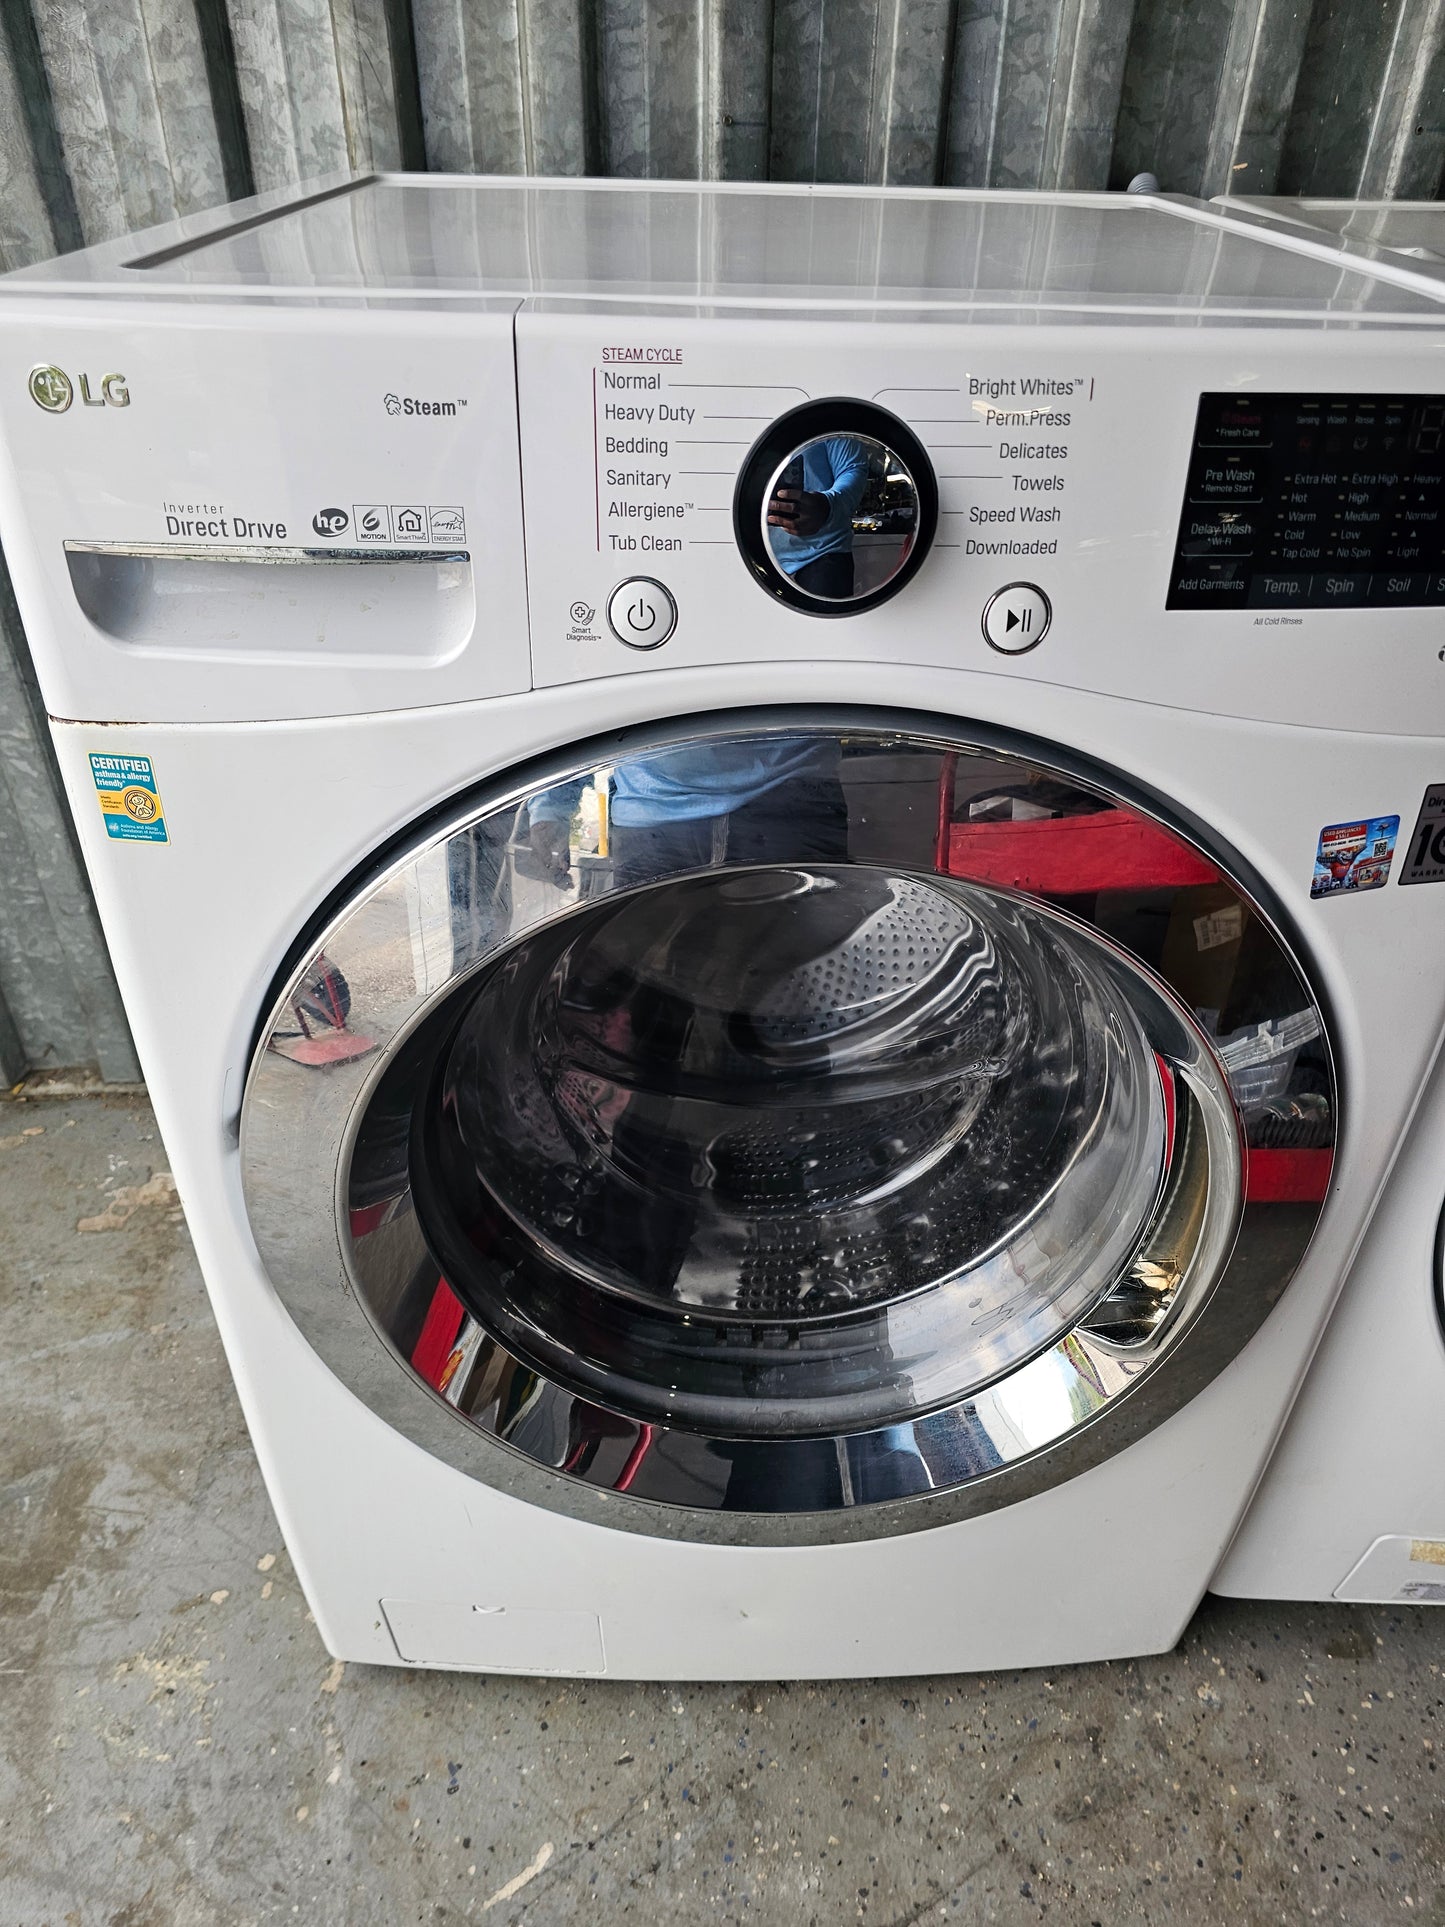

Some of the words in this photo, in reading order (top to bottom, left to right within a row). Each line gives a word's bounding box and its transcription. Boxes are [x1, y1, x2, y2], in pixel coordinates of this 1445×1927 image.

[602, 347, 644, 360] STEAM
[646, 348, 683, 361] CYCLE
[604, 372, 661, 390] Normal
[78, 372, 130, 407] LG
[969, 378, 1016, 398] Bright
[1020, 378, 1084, 396] Whites™
[605, 404, 654, 424] Heavy
[658, 405, 695, 424] Duty
[986, 409, 1072, 426] Perm.Press
[1327, 416, 1348, 424] Wash
[1354, 416, 1375, 424] Rinse
[1384, 416, 1402, 426] Spin
[1220, 428, 1240, 438] Fresh
[1241, 428, 1260, 438] Care
[606, 437, 668, 457] Bedding
[999, 442, 1068, 459] Delicates
[606, 469, 671, 489] Sanitary
[1206, 470, 1224, 480] Pre
[1226, 470, 1255, 480] Wash
[1294, 474, 1320, 484] Extra
[1321, 474, 1337, 484] Hot
[1352, 474, 1376, 484] Extra
[1376, 474, 1398, 487] High
[1413, 474, 1442, 486] Heavy
[1012, 475, 1064, 491] Towels
[1206, 484, 1233, 492] Remote
[1234, 484, 1252, 492] Start
[1290, 493, 1308, 503] Hot
[1348, 493, 1369, 504] High
[163, 501, 224, 514] Inverter
[969, 506, 1016, 526] Speed
[1020, 507, 1061, 522] Wash
[1288, 512, 1316, 522] Warm
[1344, 511, 1380, 522] Medium
[1405, 511, 1438, 522] Normal
[166, 516, 229, 538] Direct
[233, 518, 288, 540] Drive
[1191, 523, 1220, 536] Delay
[1222, 523, 1252, 534] Wash
[1284, 530, 1304, 540] Cold
[1340, 530, 1361, 540] Low
[608, 534, 636, 550] Tub
[640, 535, 682, 551] Clean
[966, 539, 1058, 555] Downloaded
[1282, 548, 1298, 560] Tap
[1300, 548, 1320, 558] Cold
[1336, 548, 1350, 558] No
[1351, 548, 1371, 560] Spin
[1396, 547, 1420, 559] Light
[1178, 580, 1198, 590] Add
[1200, 580, 1244, 590] Garments
[1264, 580, 1301, 594] Temp.
[1326, 579, 1354, 596] Spin
[1387, 578, 1411, 592] Soil
[91, 757, 150, 772] CERTIFIED
[94, 770, 120, 780] asthma
[127, 772, 151, 782] allergy
